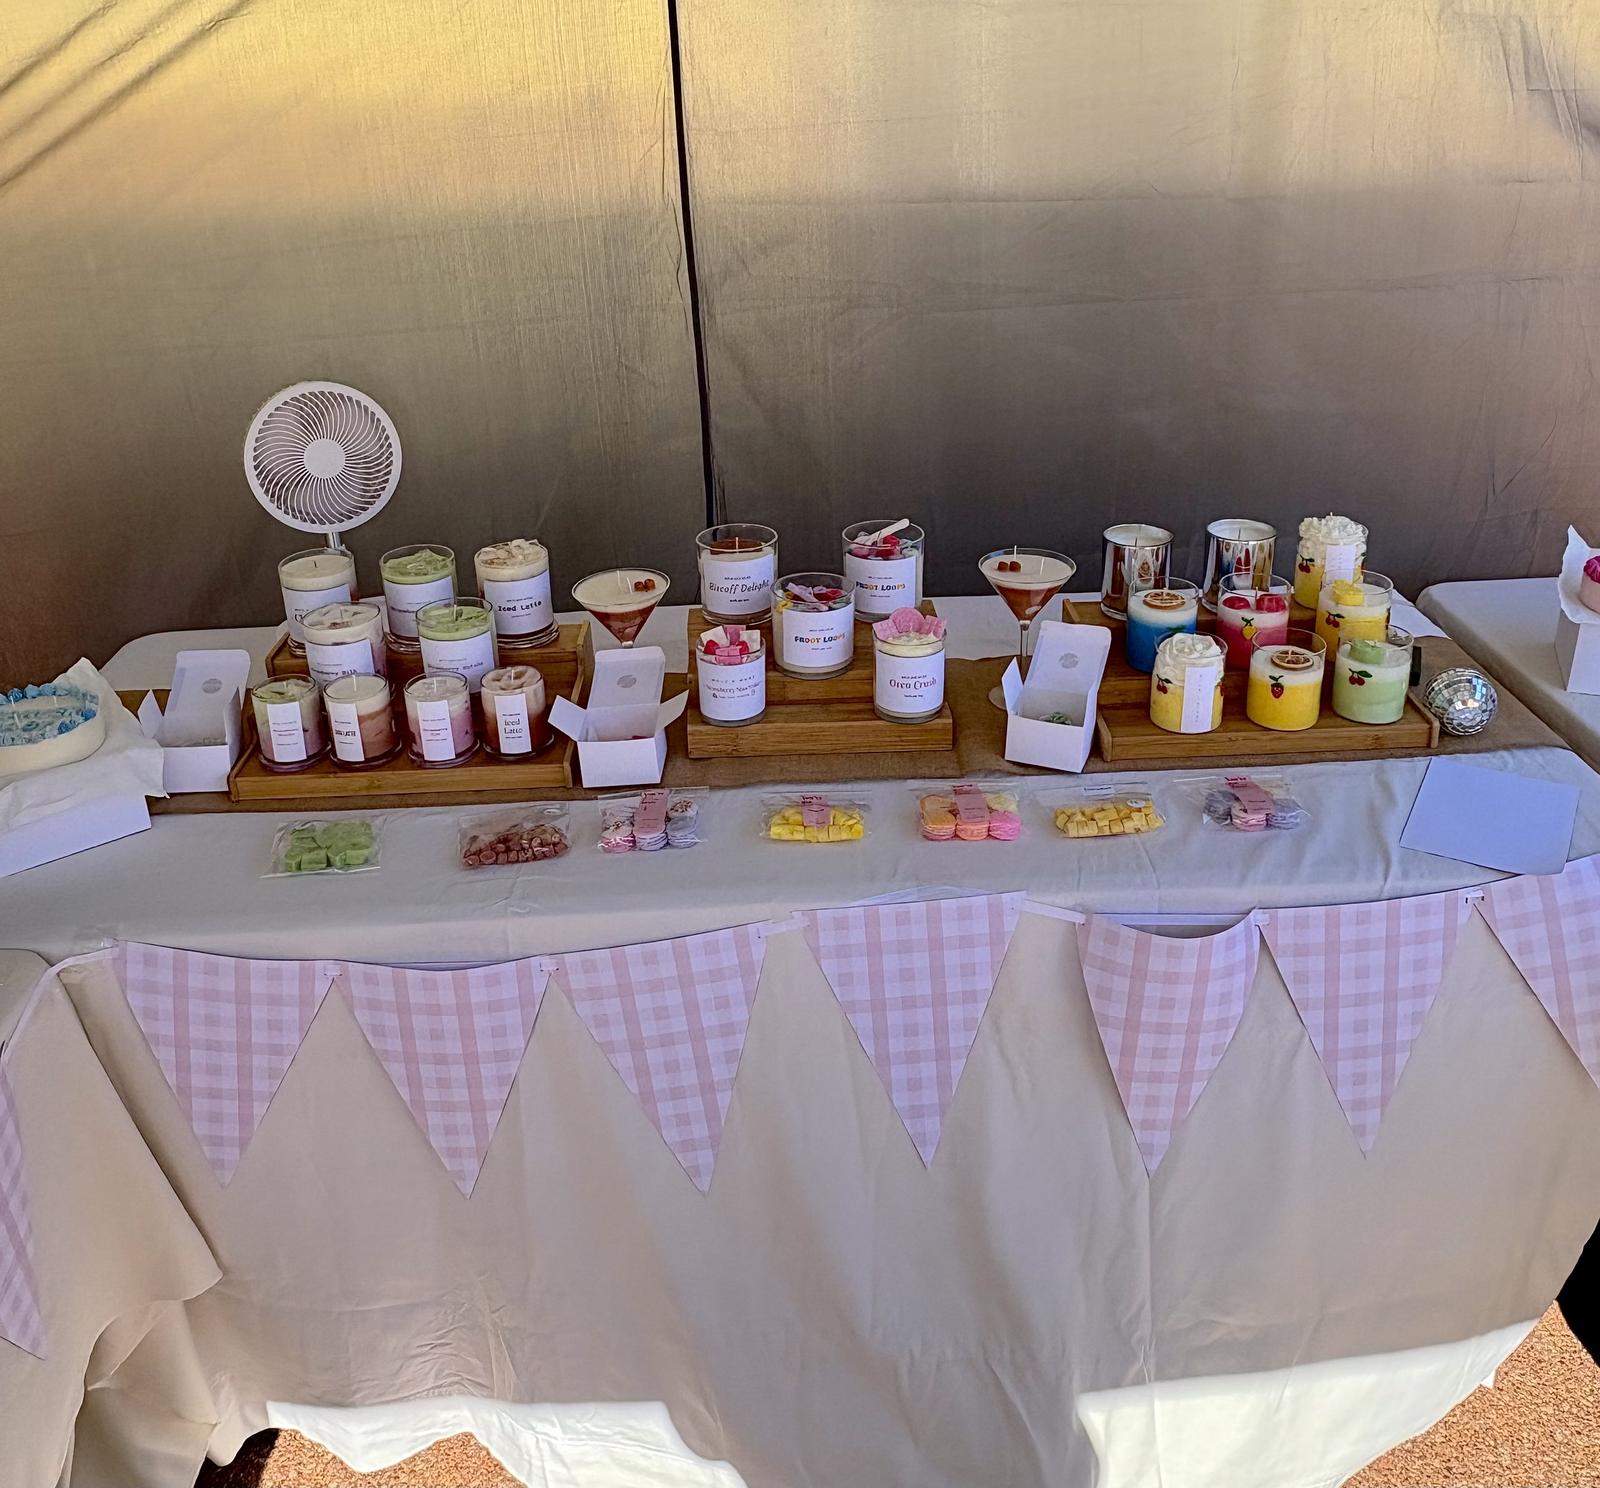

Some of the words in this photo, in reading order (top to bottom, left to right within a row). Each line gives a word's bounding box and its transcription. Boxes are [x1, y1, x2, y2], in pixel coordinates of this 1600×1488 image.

[709, 582, 740, 595] Biscoff
[794, 635, 821, 644] FROOT
[889, 679, 911, 689] Oreo
